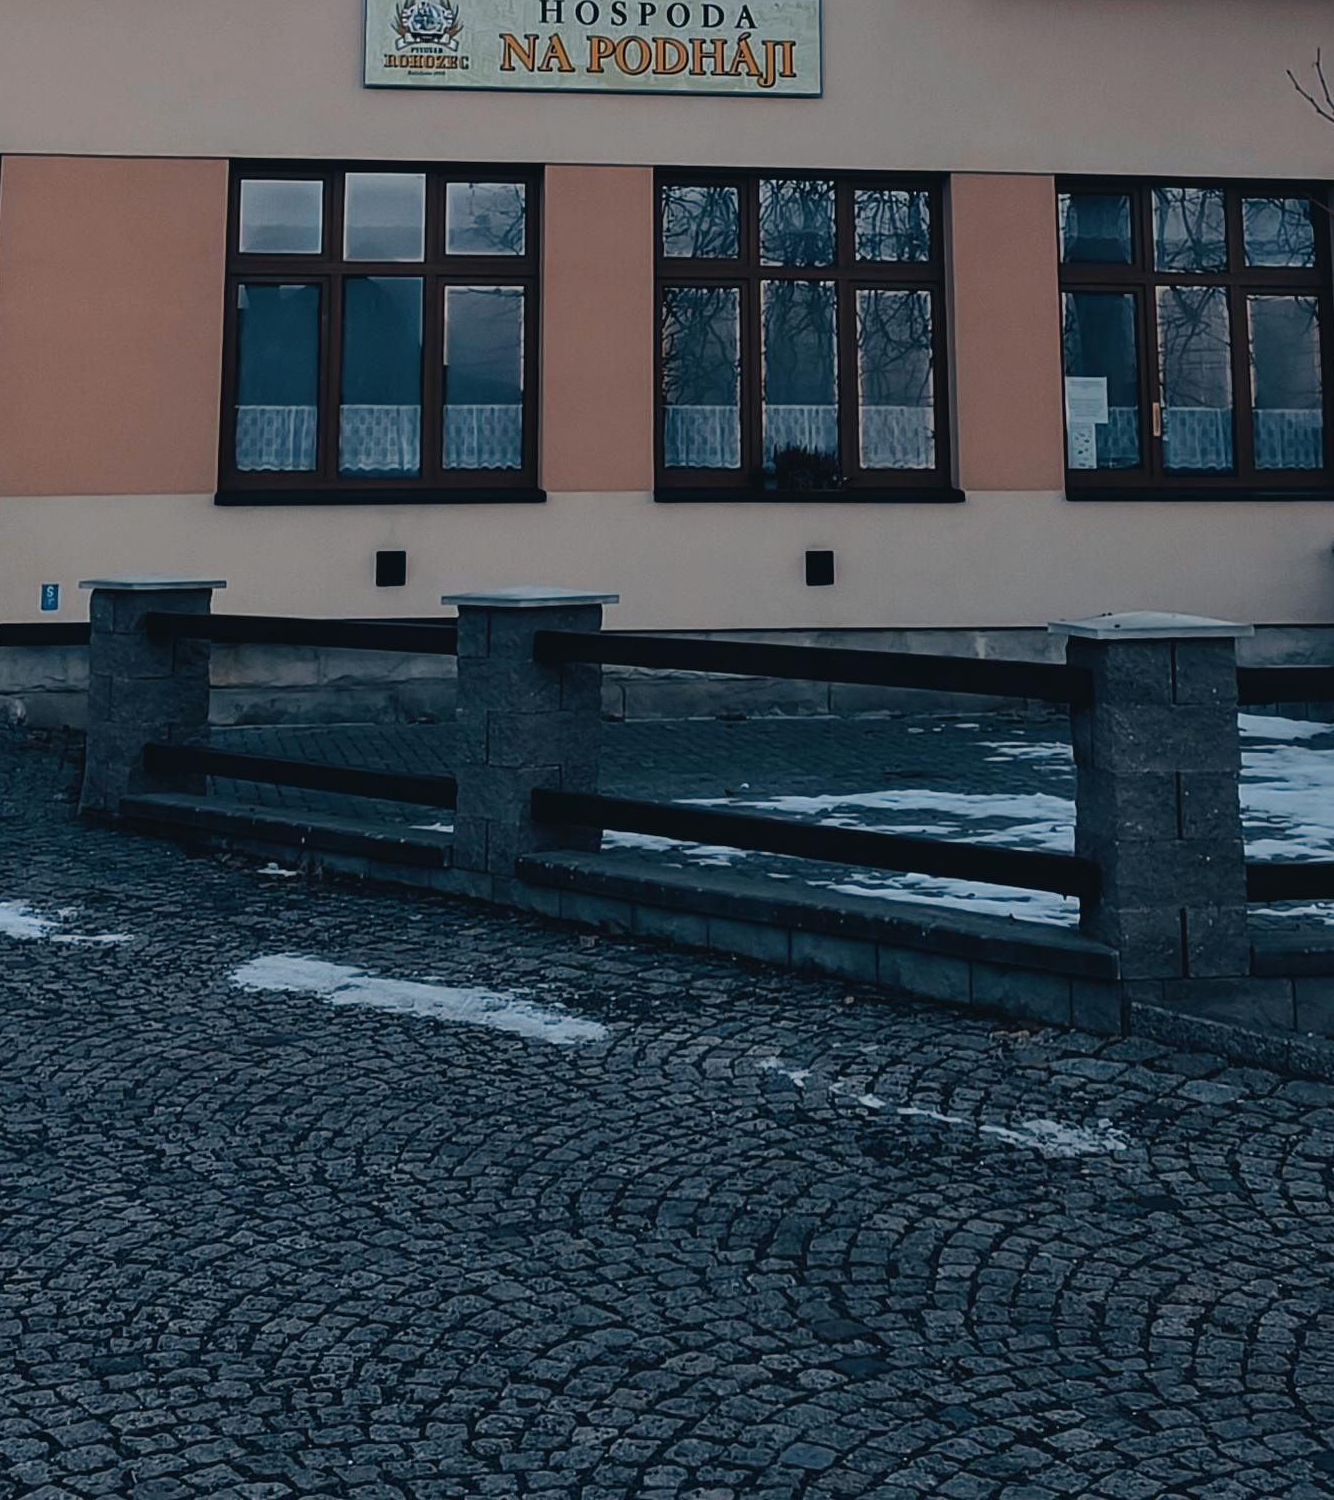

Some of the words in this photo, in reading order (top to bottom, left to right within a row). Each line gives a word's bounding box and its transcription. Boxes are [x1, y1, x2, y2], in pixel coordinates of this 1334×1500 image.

[539, 0, 757, 29] HOSPODA
[499, 33, 575, 73] NA
[586, 31, 797, 88] PODHÁJI
